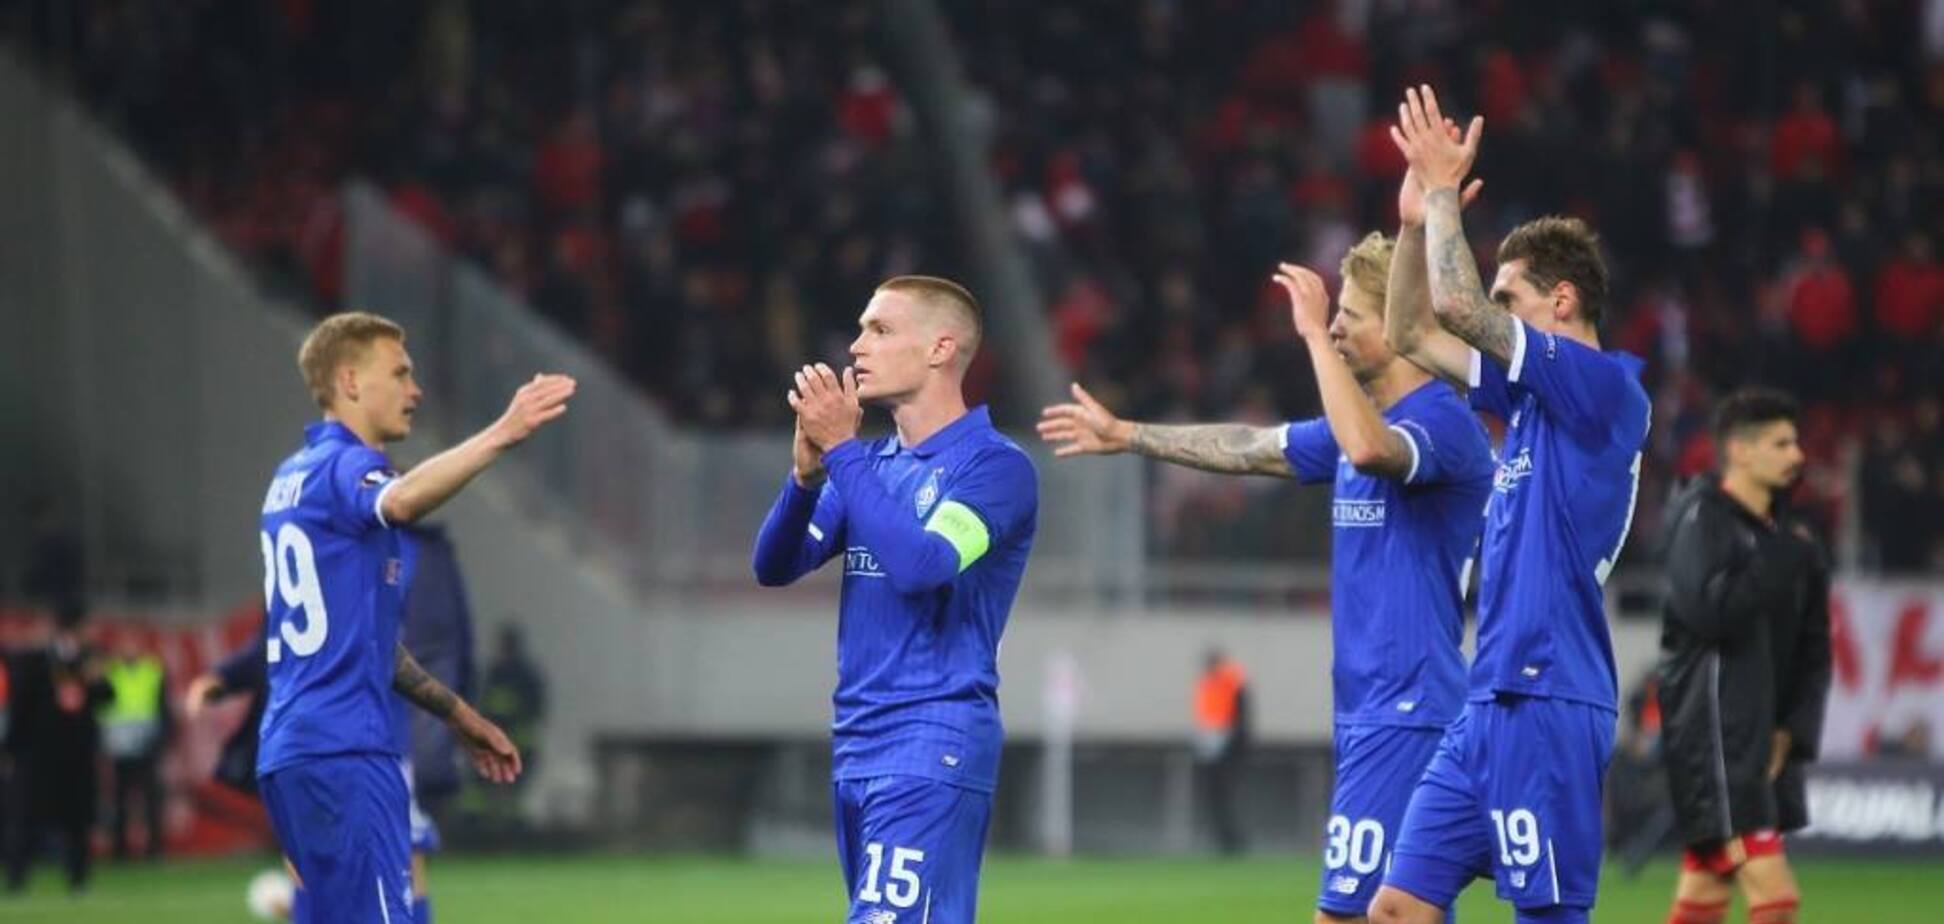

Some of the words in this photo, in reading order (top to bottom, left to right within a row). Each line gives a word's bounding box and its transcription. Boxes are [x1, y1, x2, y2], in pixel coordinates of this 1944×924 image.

[1325, 815, 1384, 874] 30
[1491, 808, 1540, 866] 19
[858, 842, 924, 908] 15
